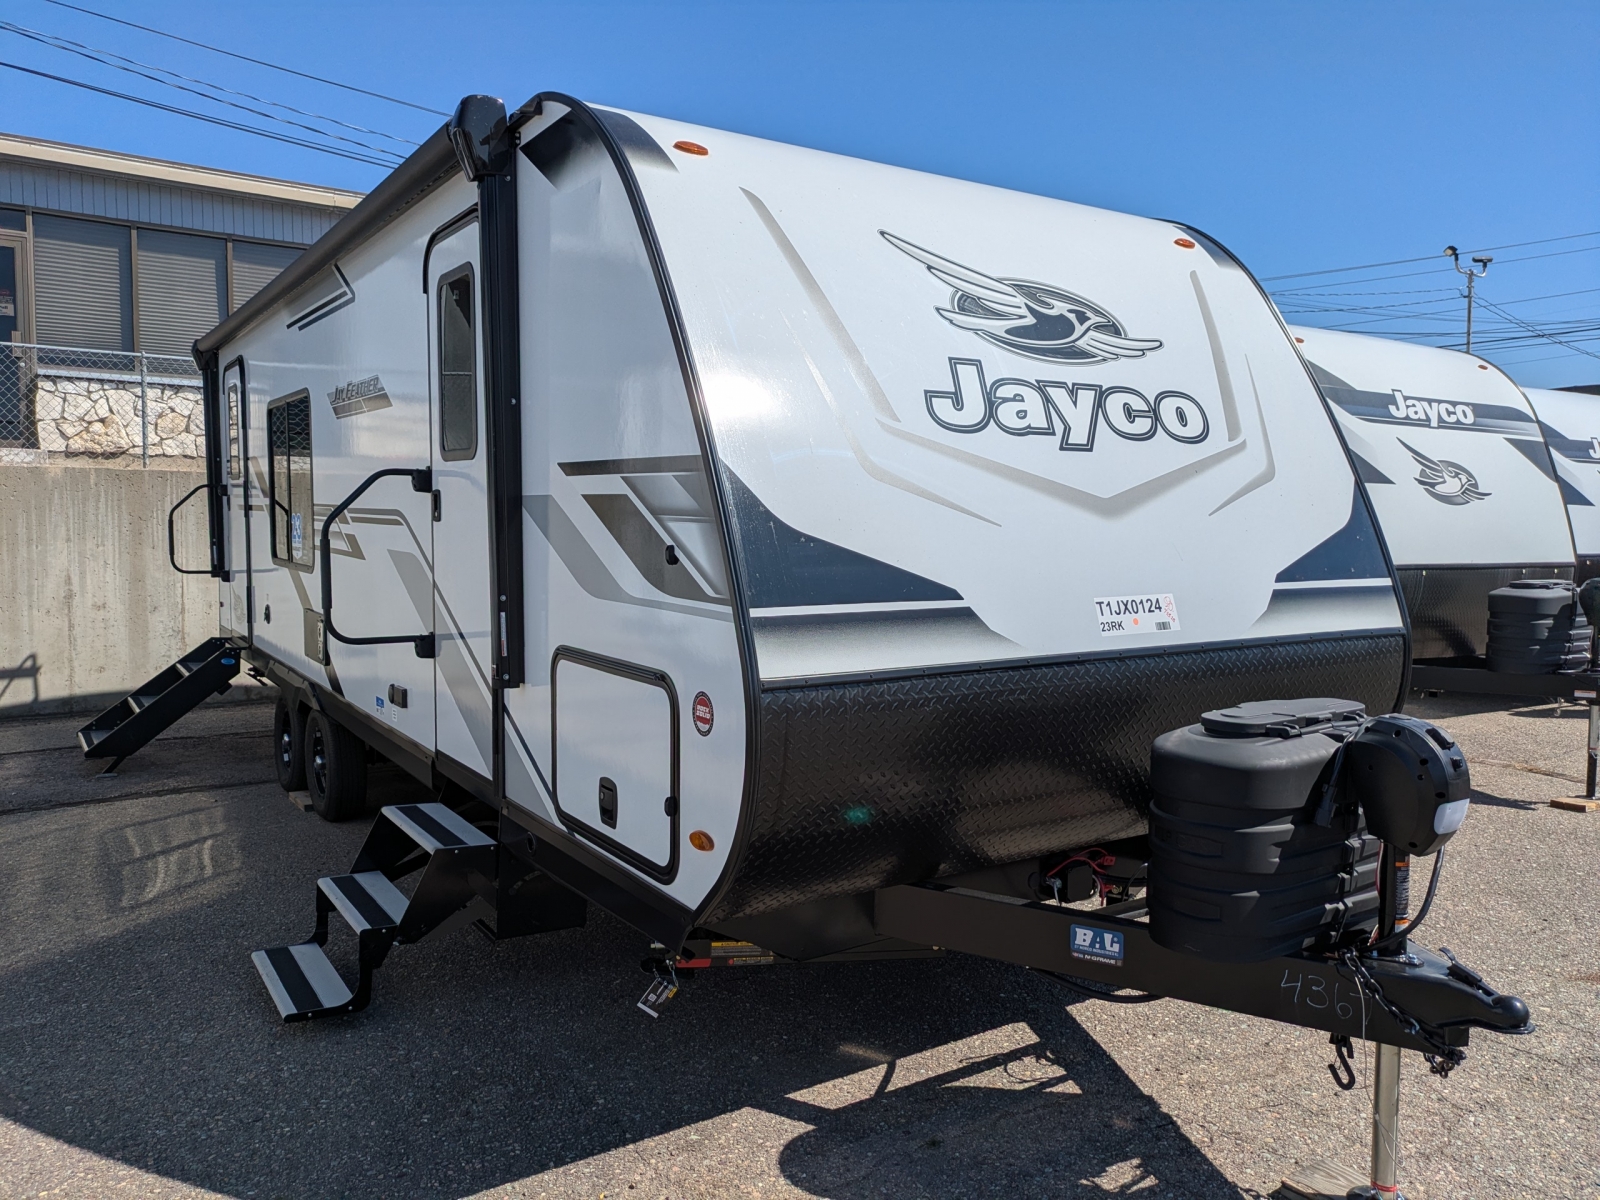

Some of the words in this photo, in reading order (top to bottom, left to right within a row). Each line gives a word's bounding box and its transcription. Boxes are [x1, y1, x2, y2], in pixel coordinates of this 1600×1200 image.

[345, 374, 380, 400] FEATHER
[924, 357, 1209, 452] Jayco
[1388, 389, 1475, 429] Jayco
[1095, 598, 1162, 616] T1JX0124
[1100, 621, 1125, 632] 23RK
